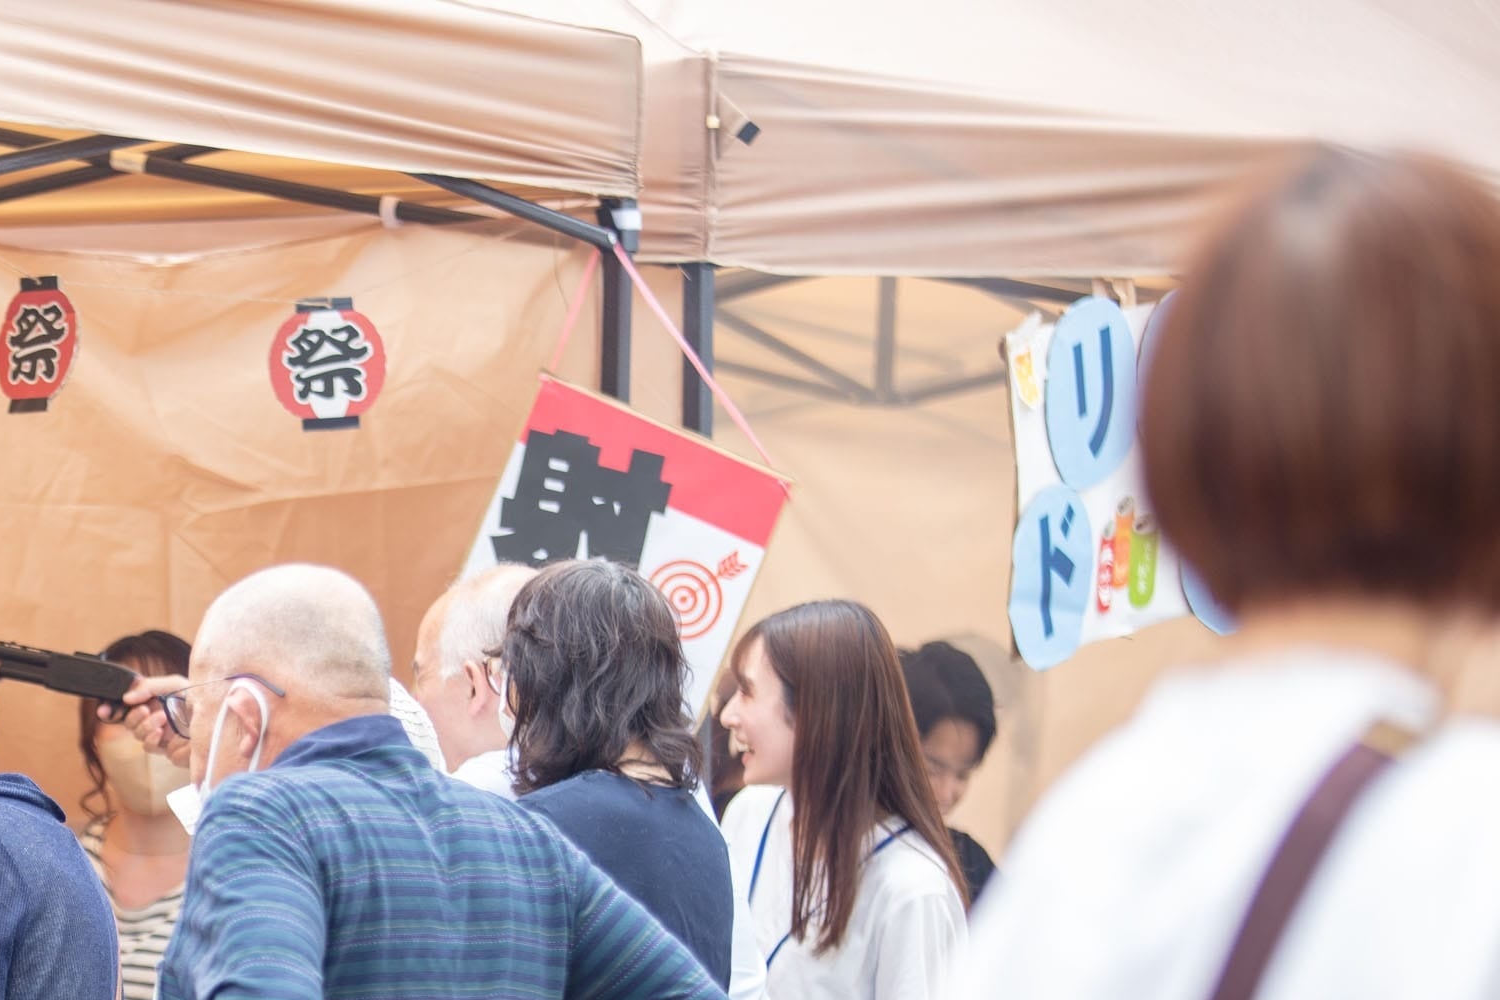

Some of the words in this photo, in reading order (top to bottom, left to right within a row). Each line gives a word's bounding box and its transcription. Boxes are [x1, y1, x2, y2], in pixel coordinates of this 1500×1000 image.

[8, 304, 67, 383] 祭
[284, 322, 373, 405] 祭
[1038, 503, 1076, 641] ド
